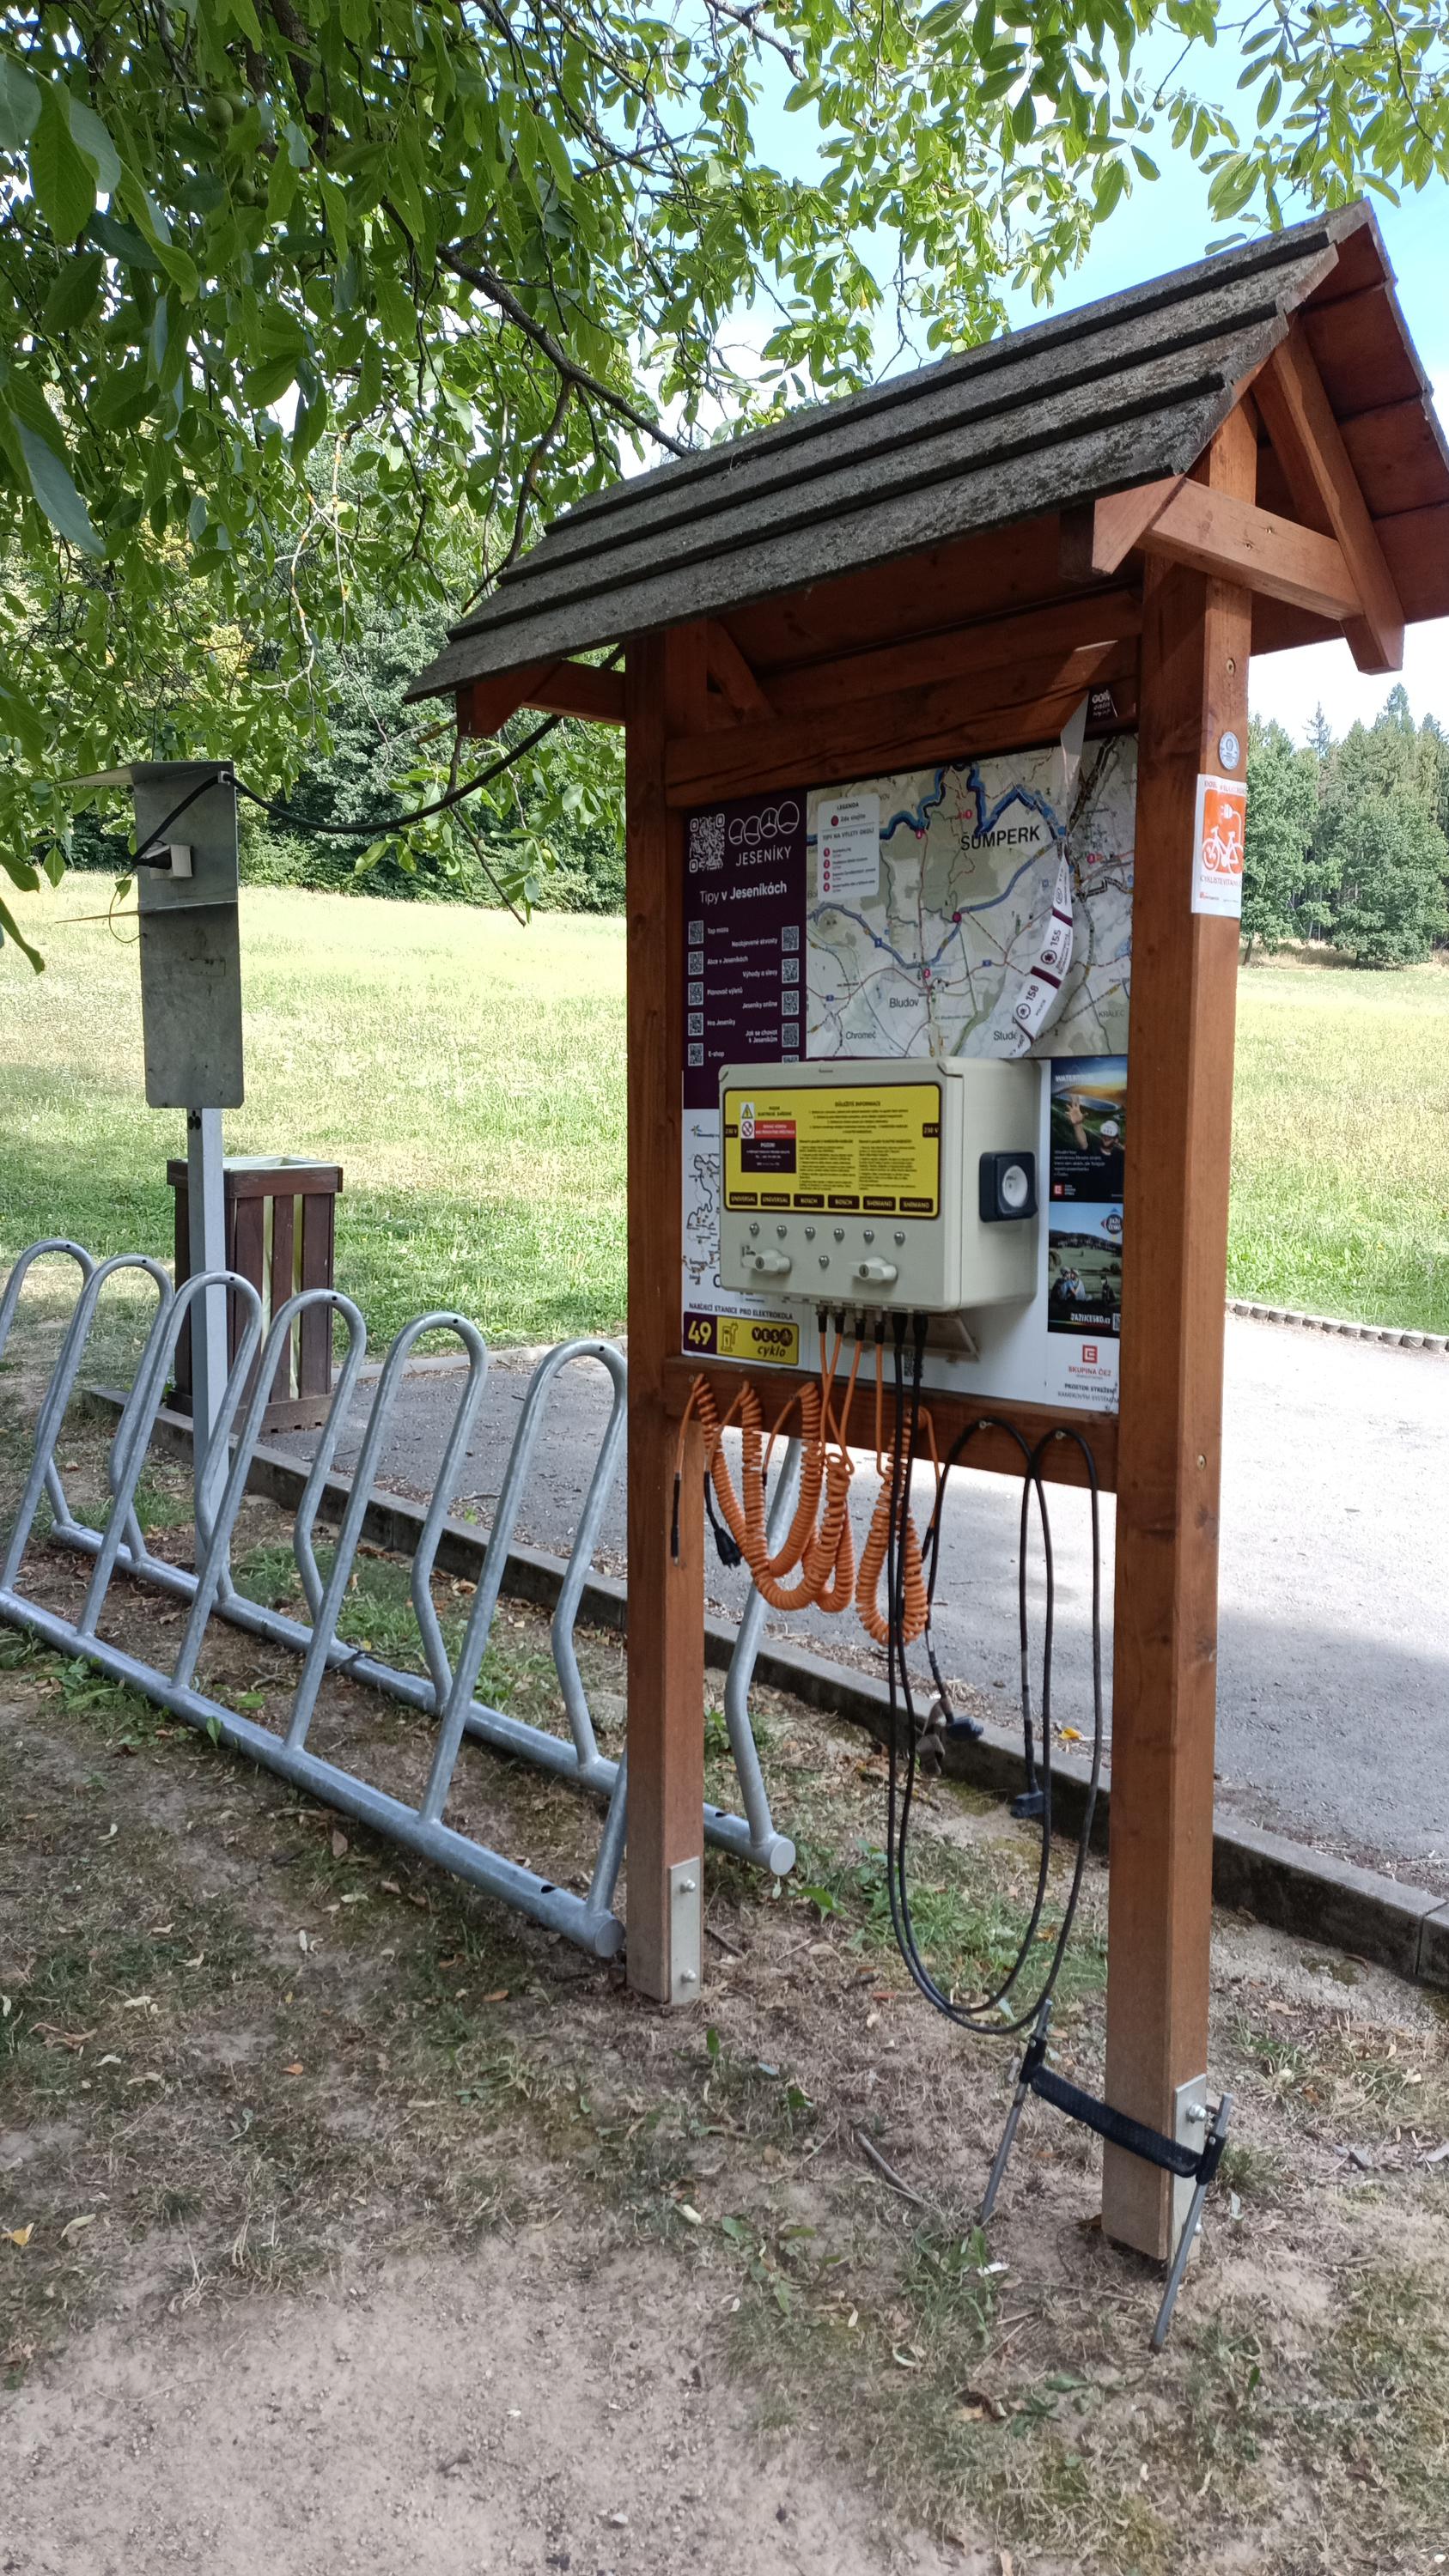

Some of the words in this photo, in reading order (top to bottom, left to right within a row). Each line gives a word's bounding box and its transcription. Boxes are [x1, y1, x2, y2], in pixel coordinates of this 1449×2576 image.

[960, 824, 1041, 851] ŠUMPERK
[736, 845, 792, 866] JESENÍKY
[700, 890, 720, 906] Tipy
[721, 890, 728, 901] v
[1050, 929, 1062, 946] 155
[889, 997, 919, 1009] Bludov
[1026, 985, 1039, 1003] 158
[715, 1303, 738, 1315] STANICE
[740, 1307, 752, 1316] PRO
[752, 1309, 793, 1321] ELEKTROKOLA
[688, 1320, 712, 1346] 49
[757, 1344, 786, 1358] cyklo
